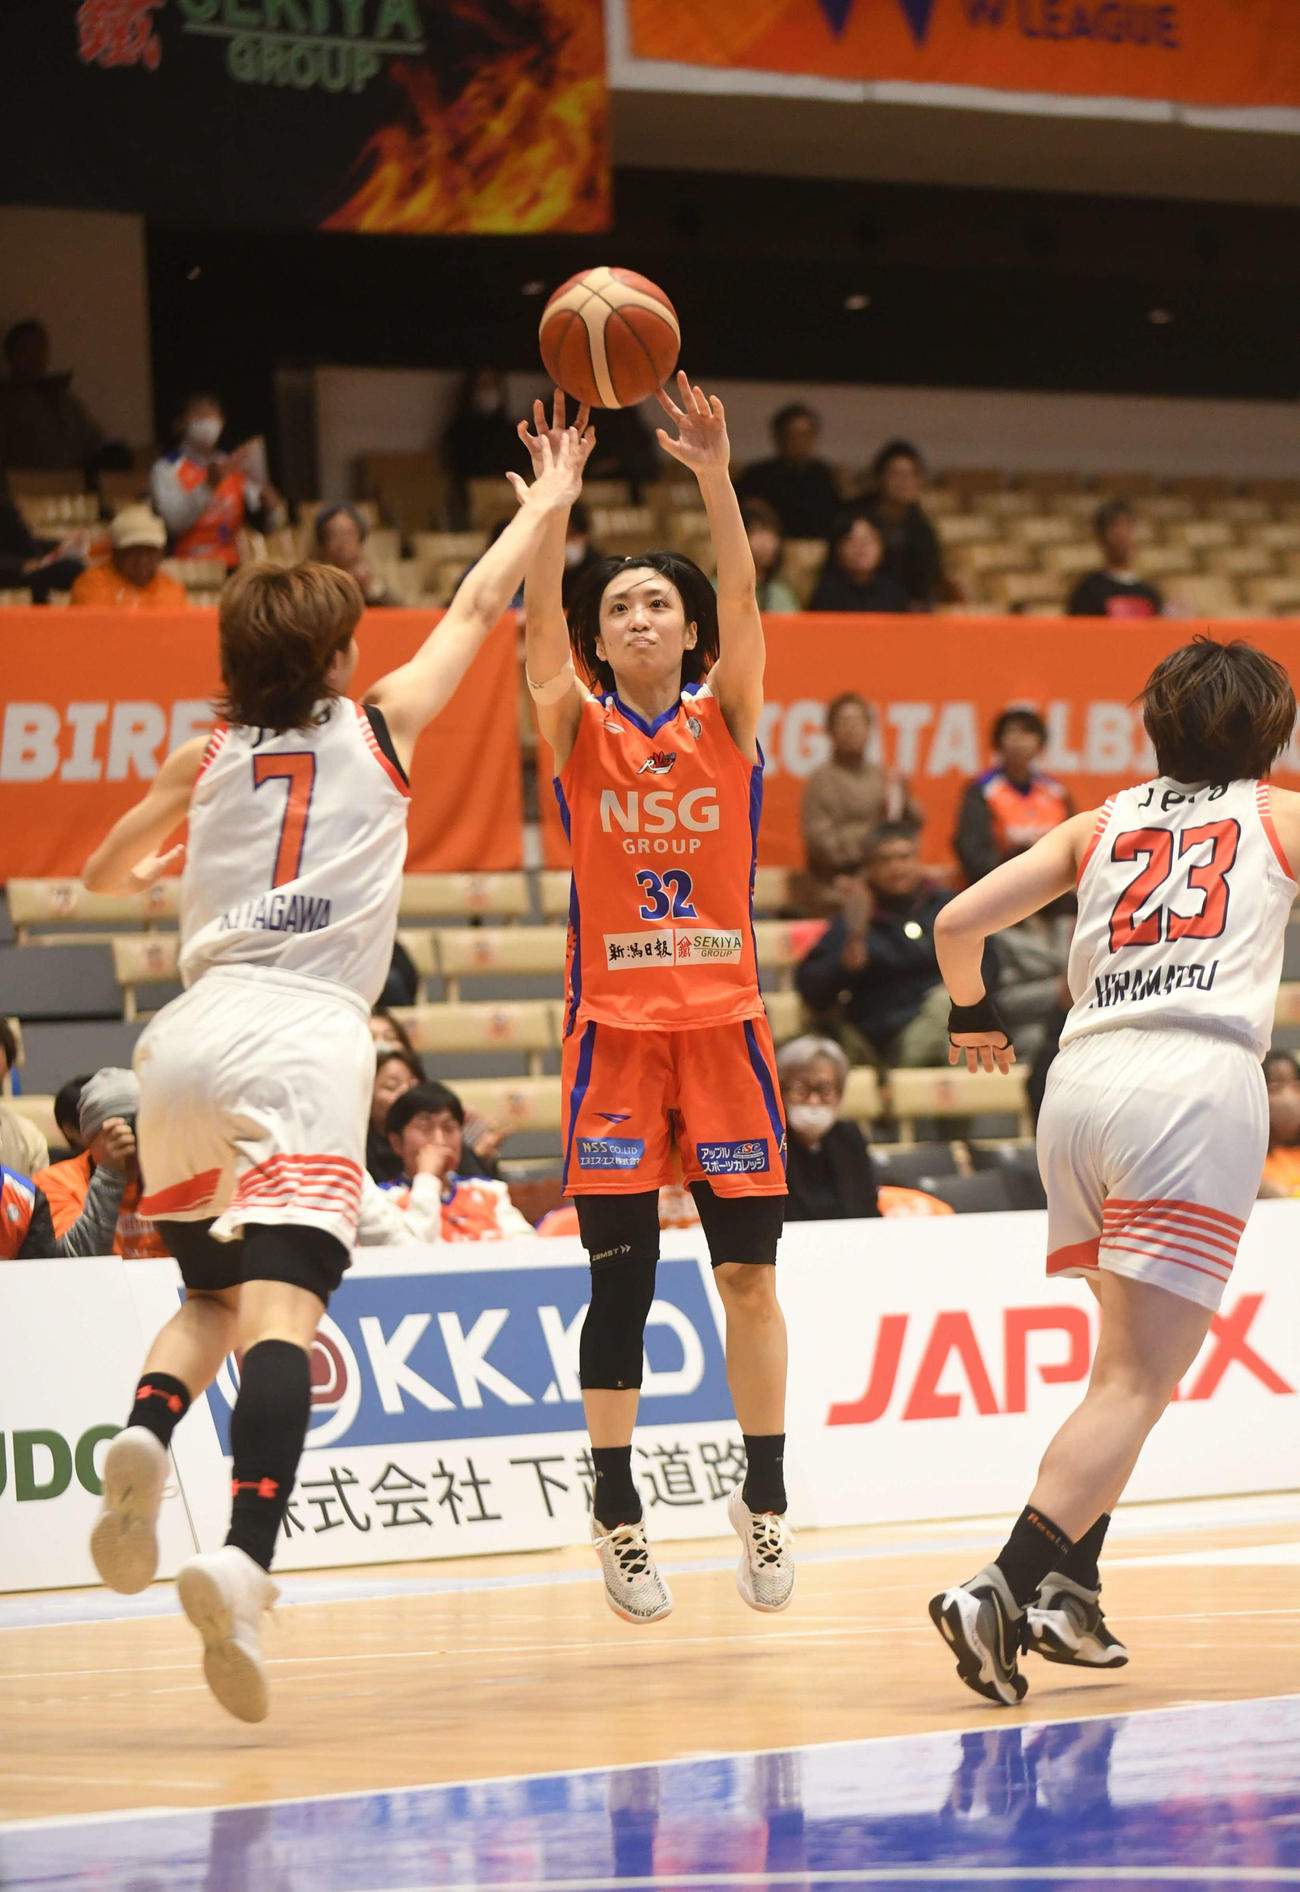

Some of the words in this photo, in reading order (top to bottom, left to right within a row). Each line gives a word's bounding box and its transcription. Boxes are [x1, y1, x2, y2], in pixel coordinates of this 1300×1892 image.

[228, 36, 381, 94] GROUP
[253, 752, 316, 890] 7
[600, 787, 720, 834] NSG
[622, 838, 702, 854] GROUP
[635, 868, 699, 921] 32
[1108, 818, 1241, 954] 23
[608, 937, 672, 962] 新潟日報
[693, 935, 742, 948] SEKIYA
[701, 949, 733, 958] GROUP
[582, 1141, 608, 1154] NSS
[701, 1146, 730, 1160] アップル
[702, 1157, 766, 1173] スポーツカレッジ
[825, 1293, 1297, 1426] JAPX
